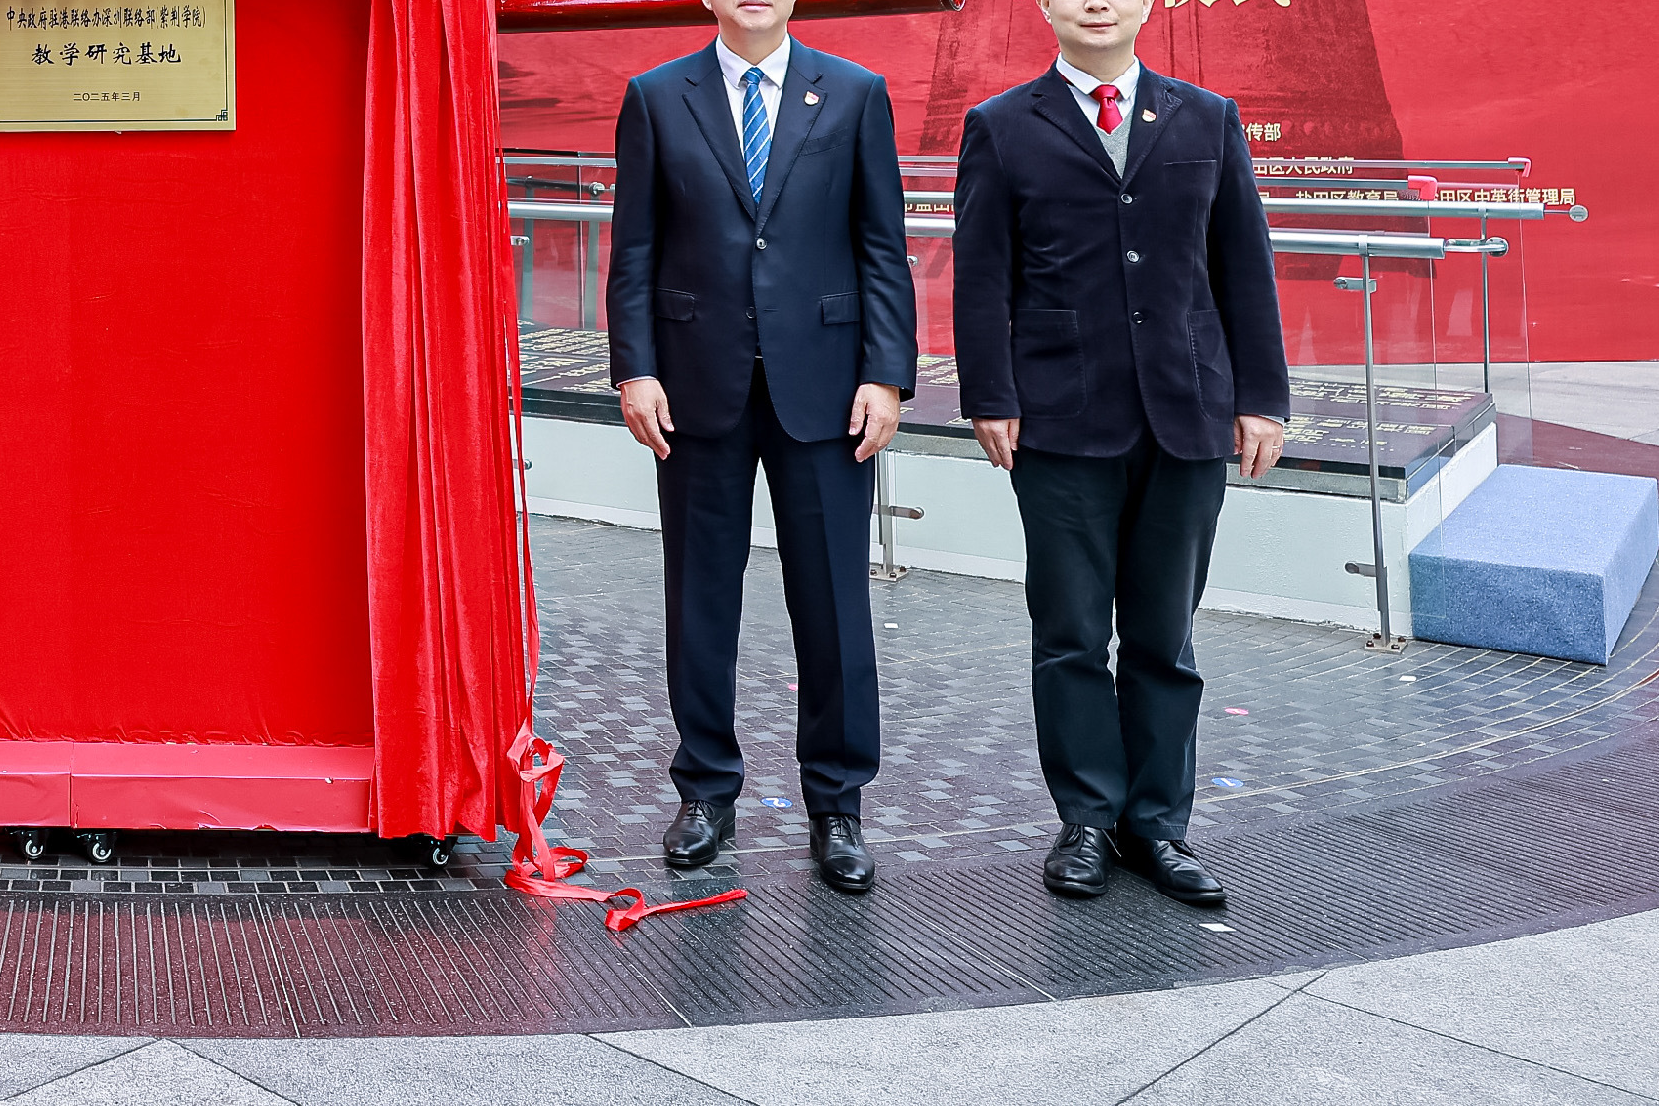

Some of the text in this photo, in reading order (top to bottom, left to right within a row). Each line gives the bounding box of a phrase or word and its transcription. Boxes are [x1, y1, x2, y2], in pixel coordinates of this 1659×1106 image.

[31, 42, 182, 66] 教学研究基地
[1242, 122, 1282, 142] 传部
[1433, 188, 1575, 206] 田区中英街管理局
